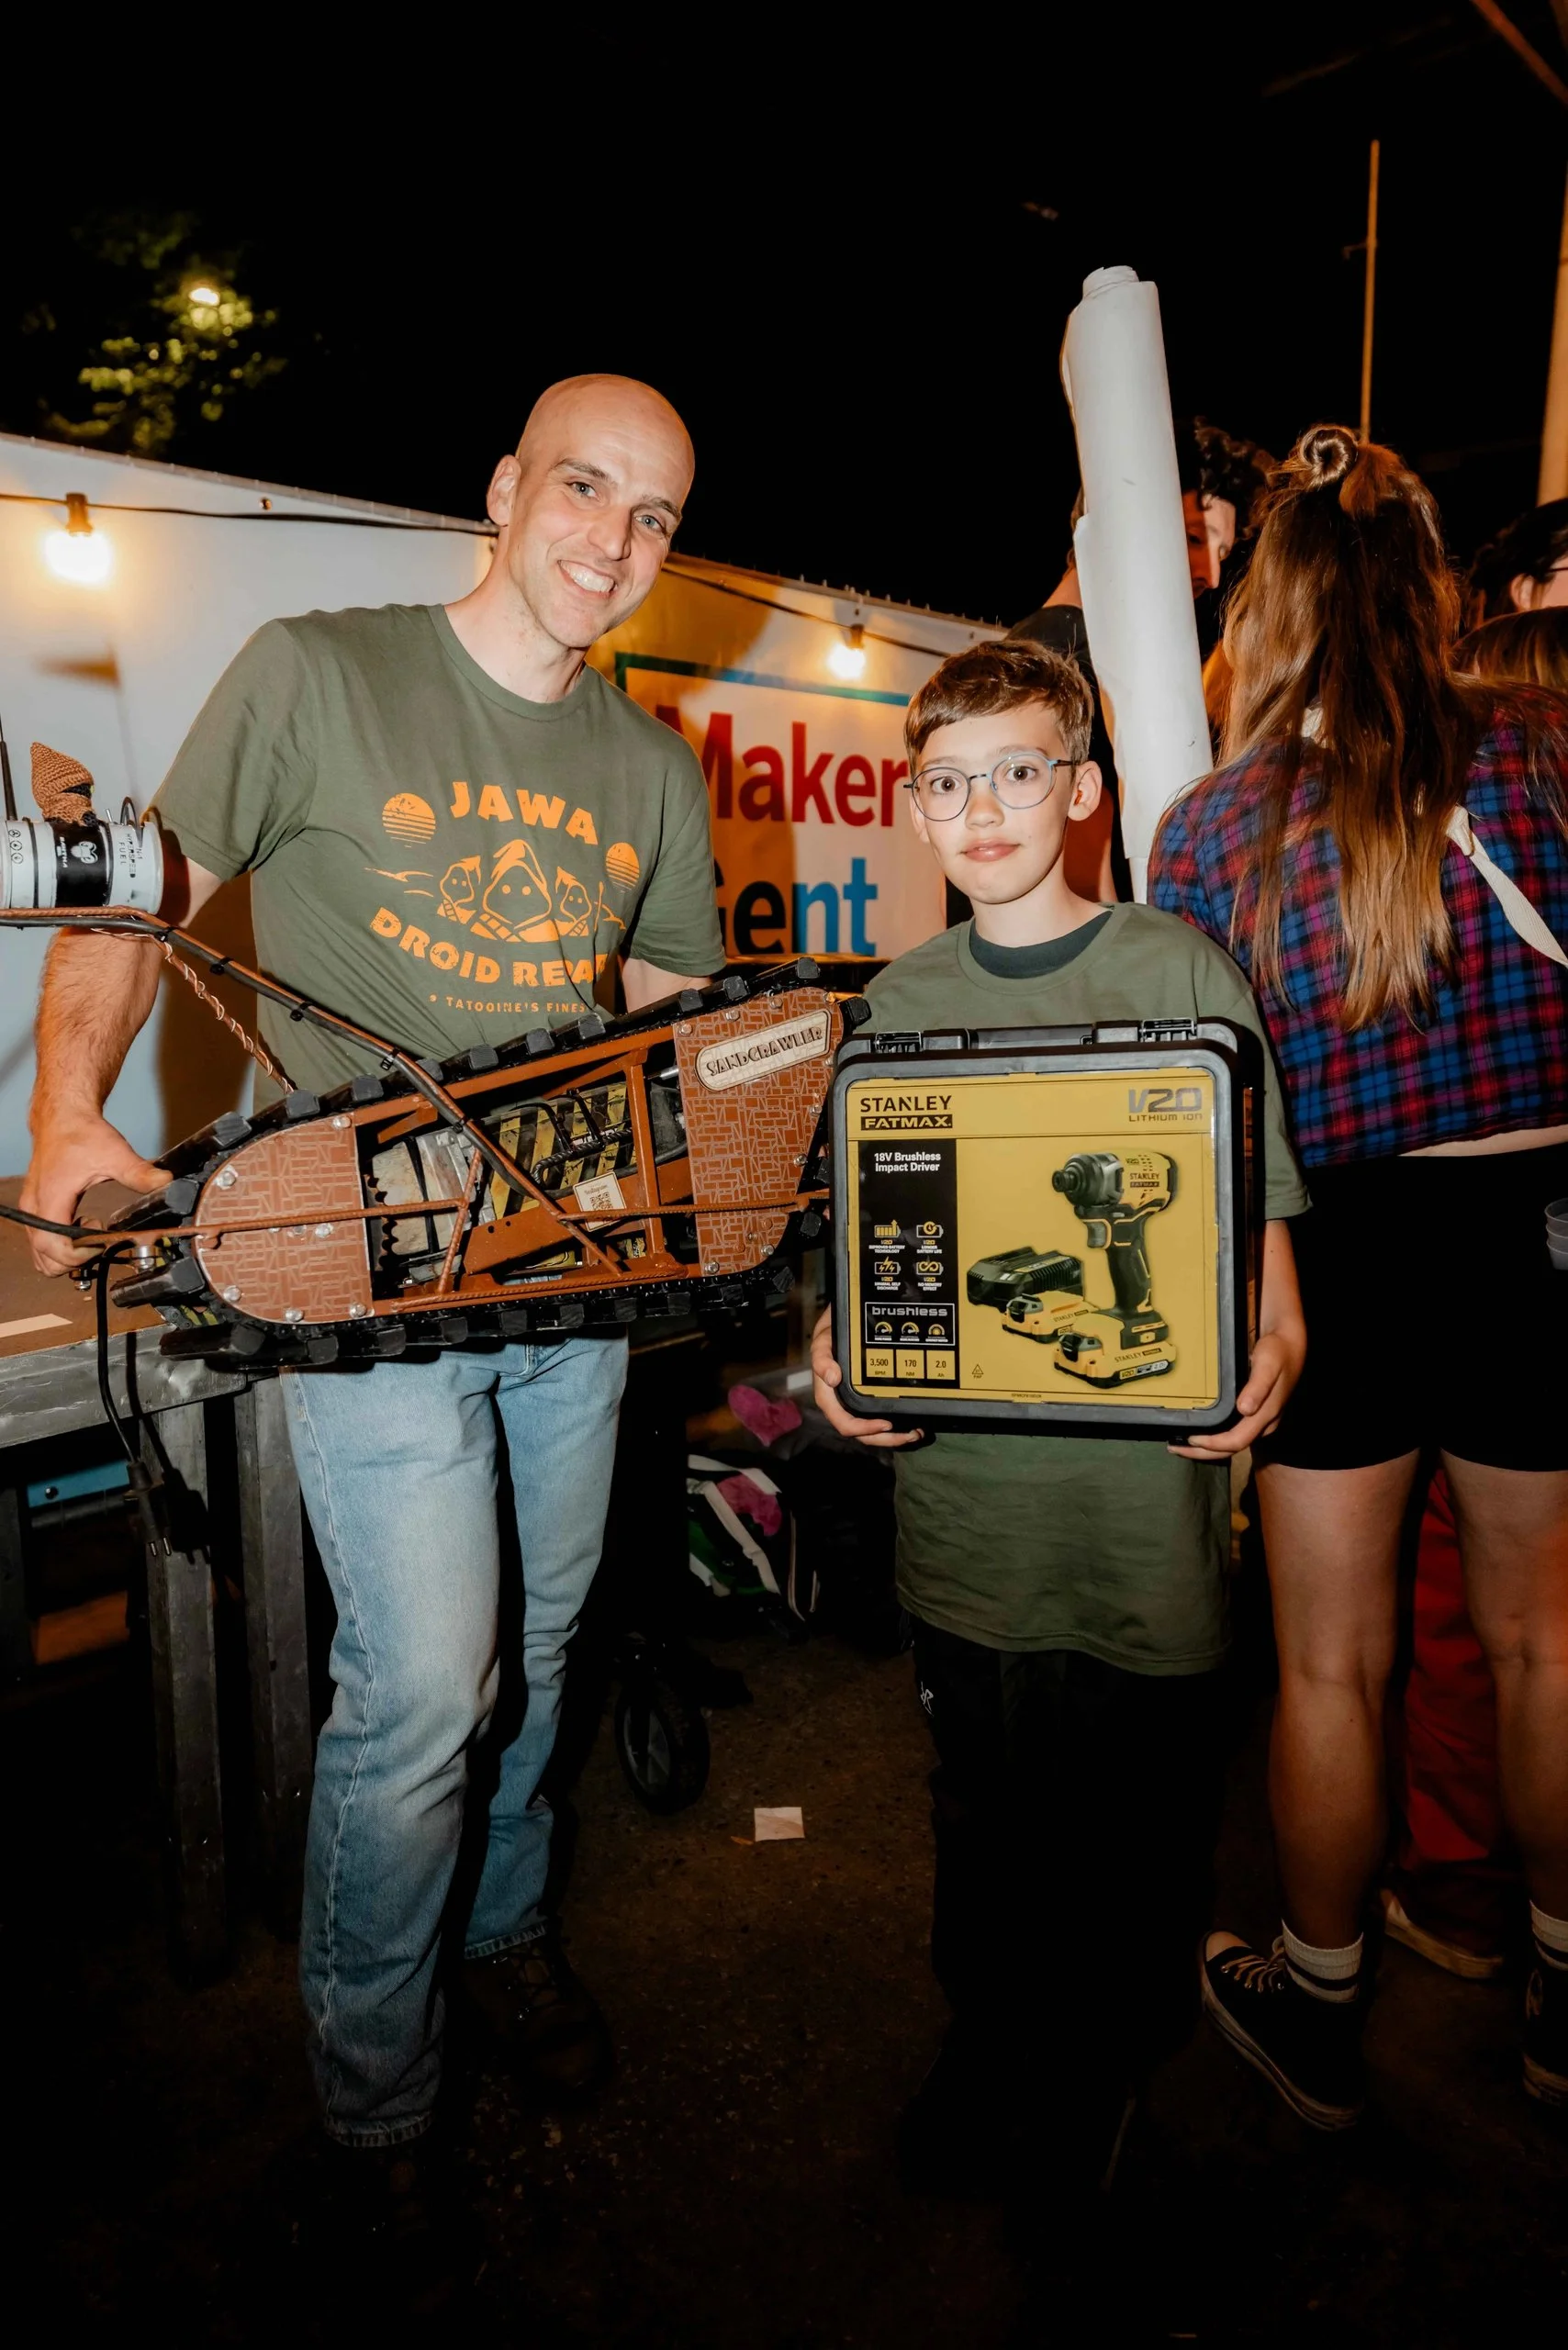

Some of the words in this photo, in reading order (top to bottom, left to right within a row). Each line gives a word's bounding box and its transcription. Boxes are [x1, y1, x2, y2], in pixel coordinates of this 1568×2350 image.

[655, 705, 908, 827] Maker
[450, 781, 598, 845] JAWA
[118, 842, 127, 865] FUEL
[126, 833, 136, 878] HYPERSPEED
[370, 907, 500, 983] DROID
[445, 996, 540, 1013] TATOOINE'S
[546, 1002, 586, 1013] FINES
[706, 1026, 823, 1077] SANDCRAWLER
[860, 1095, 952, 1113] STANLEY
[1128, 1087, 1203, 1113] V20
[874, 1152, 892, 1161] 18V
[894, 1151, 941, 1161] Brushless
[875, 1162, 908, 1173] Impact
[910, 1161, 940, 1171] Driver
[871, 1305, 948, 1316] brushless
[869, 1359, 889, 1367] 3,500
[1114, 1352, 1141, 1362] STANLEY
